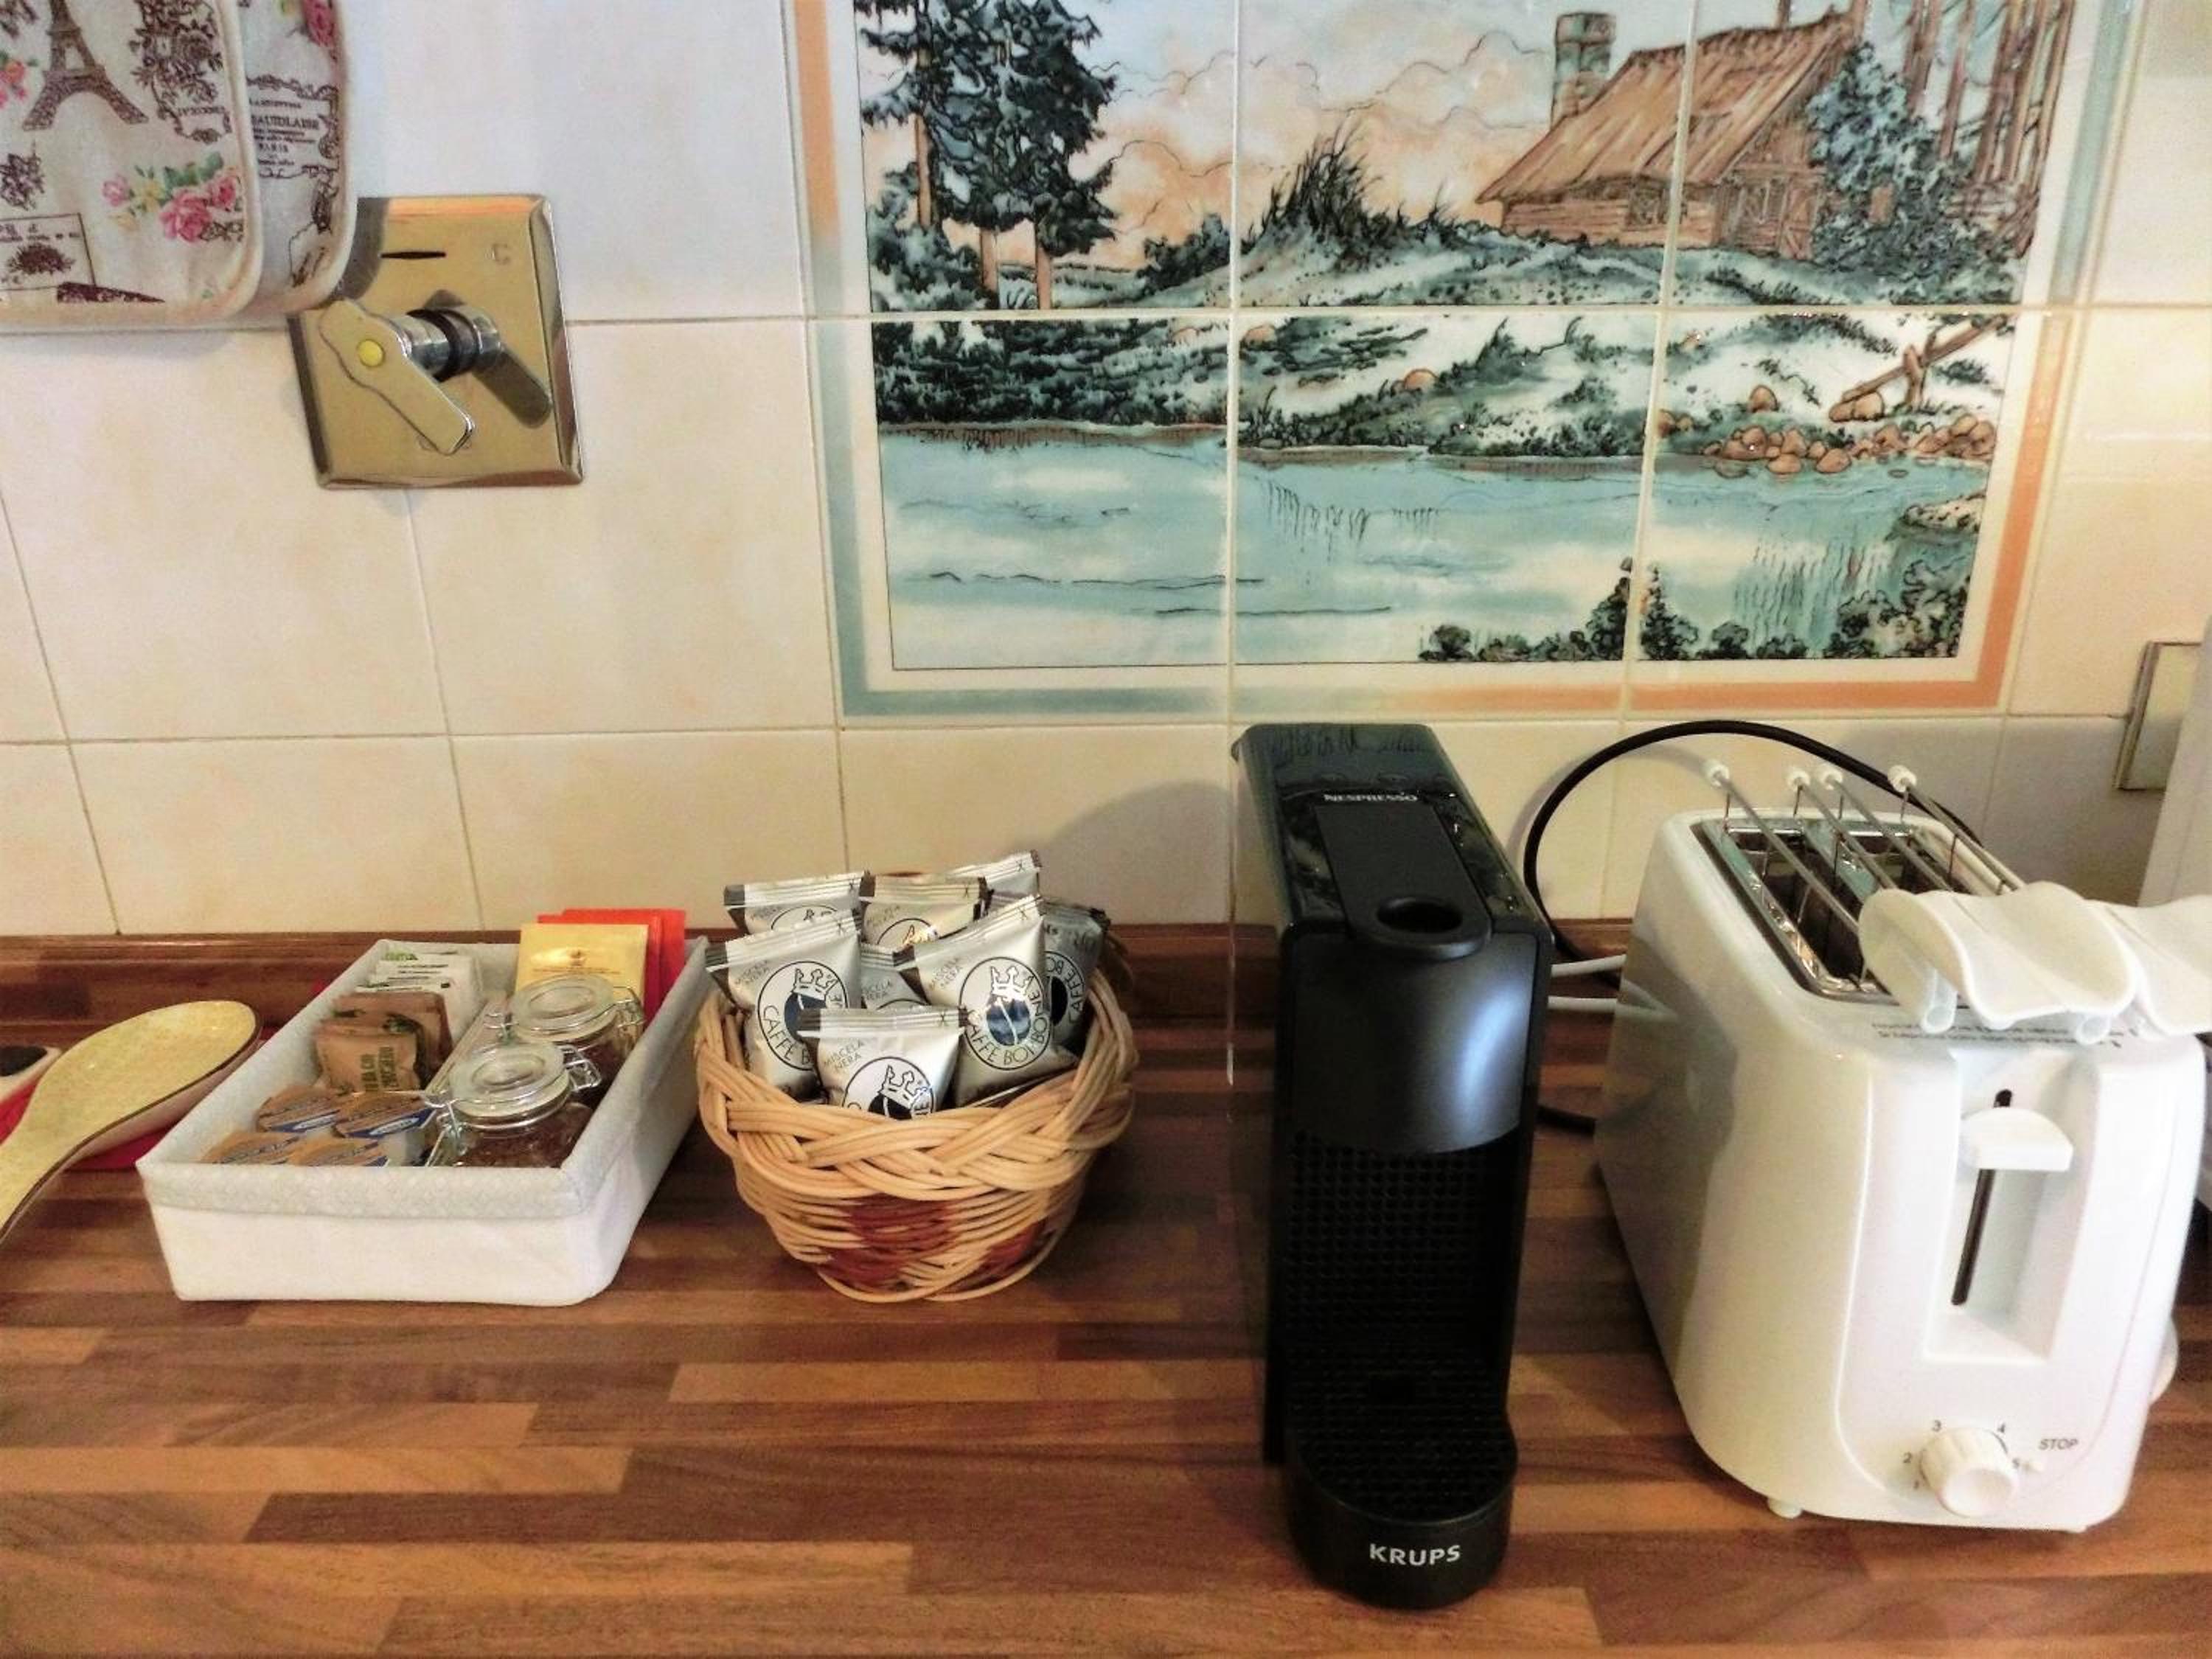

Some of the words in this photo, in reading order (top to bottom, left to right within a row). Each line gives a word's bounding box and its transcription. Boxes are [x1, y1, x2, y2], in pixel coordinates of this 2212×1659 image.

[1932, 1420, 1941, 1432] 3
[2038, 1439, 2078, 1450] STOP
[1903, 1452, 1913, 1464] 2
[1369, 1543, 1461, 1565] KRUPS
